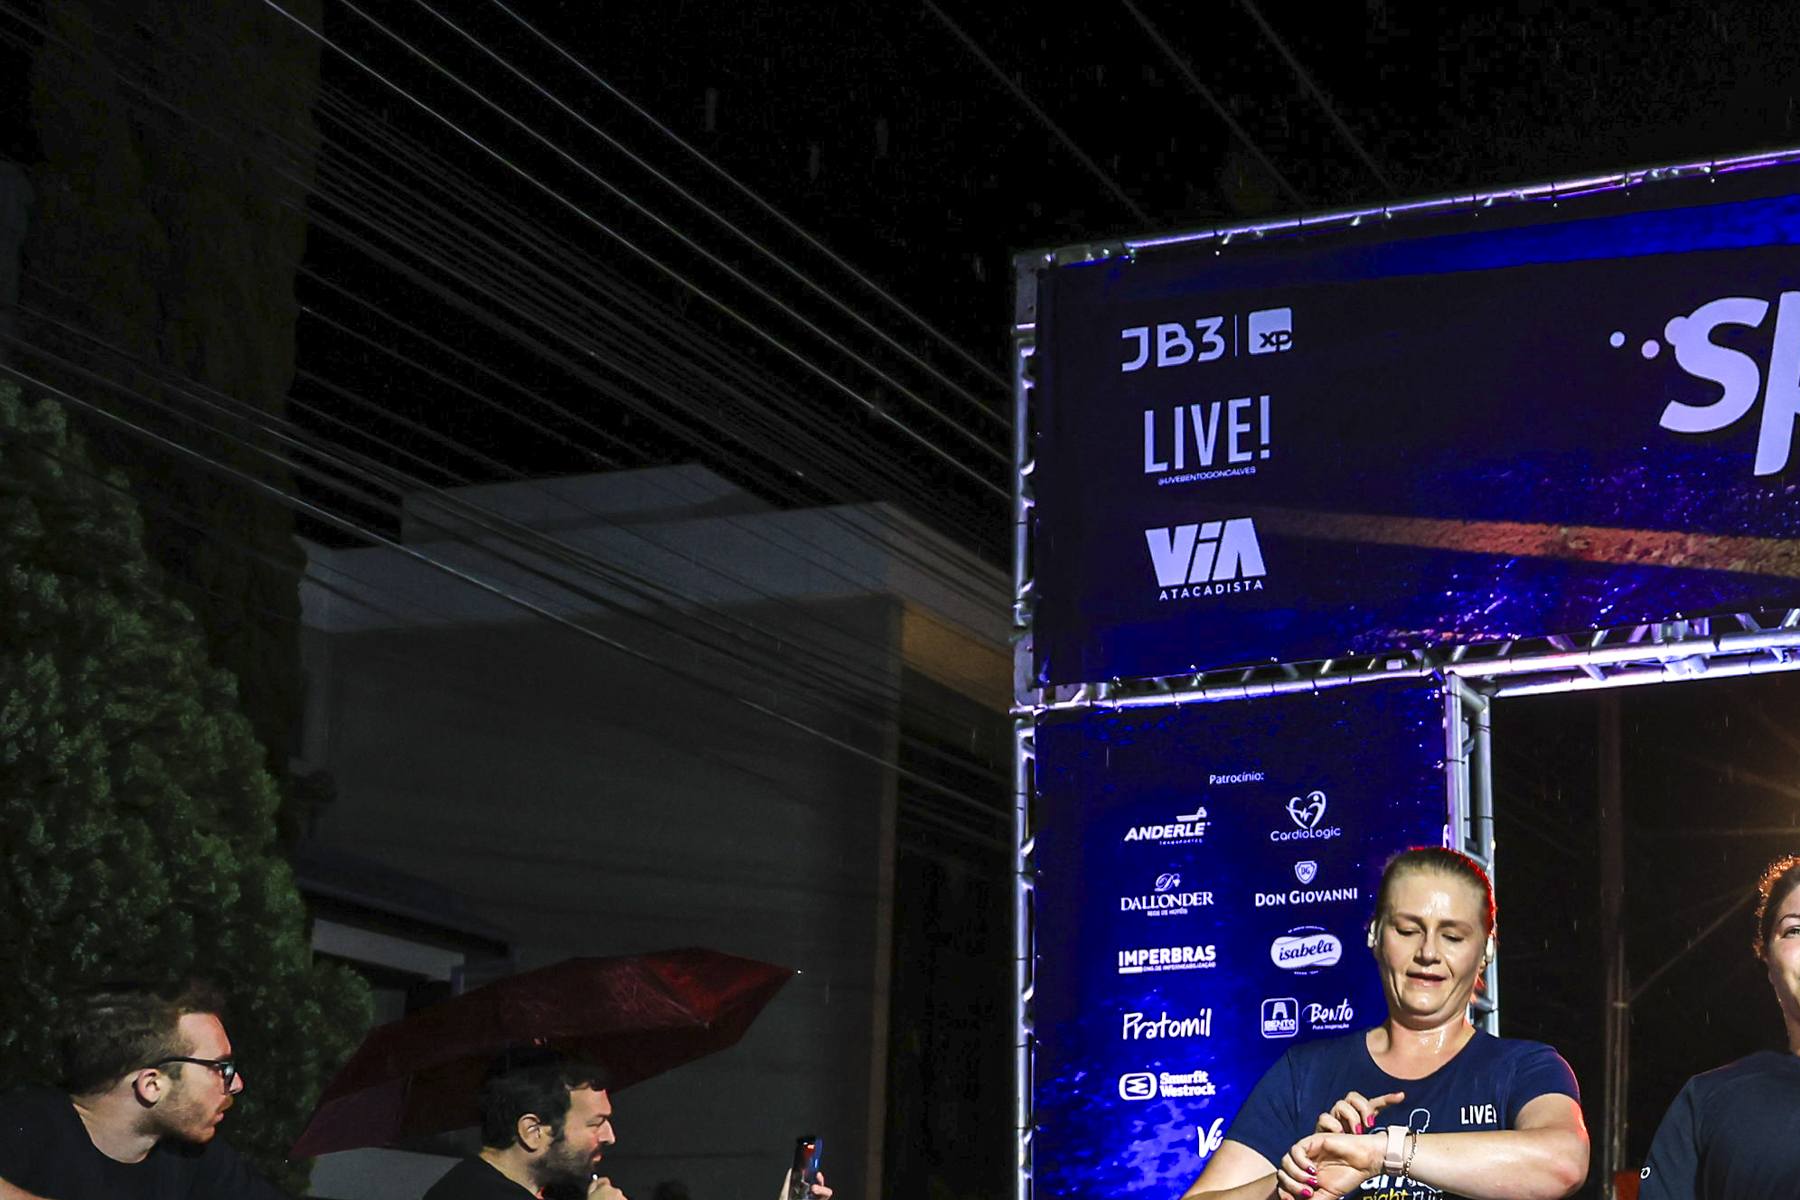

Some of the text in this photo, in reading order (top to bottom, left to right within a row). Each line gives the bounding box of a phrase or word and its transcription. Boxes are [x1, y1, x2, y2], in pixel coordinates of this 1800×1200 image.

[1121, 316, 1225, 372] JB3
[1144, 395, 1271, 473] LIVE!
[1159, 580, 1264, 600] ATACADISTA
[1210, 771, 1264, 785] Patrocínio:
[1124, 822, 1206, 842] ANDERLE
[1270, 825, 1341, 843] CardioLogic
[1255, 887, 1358, 907] DON GIOVANNI
[1118, 945, 1216, 967] IMPERBRAS
[1279, 939, 1335, 961] isabela
[1303, 998, 1353, 1023] Bento
[1123, 1008, 1212, 1039] Pratomil
[1160, 1070, 1208, 1084] Smurfit
[1160, 1082, 1215, 1098] Westrock
[1461, 1104, 1497, 1124] LIVE!
[1197, 1117, 1224, 1158] Vi
